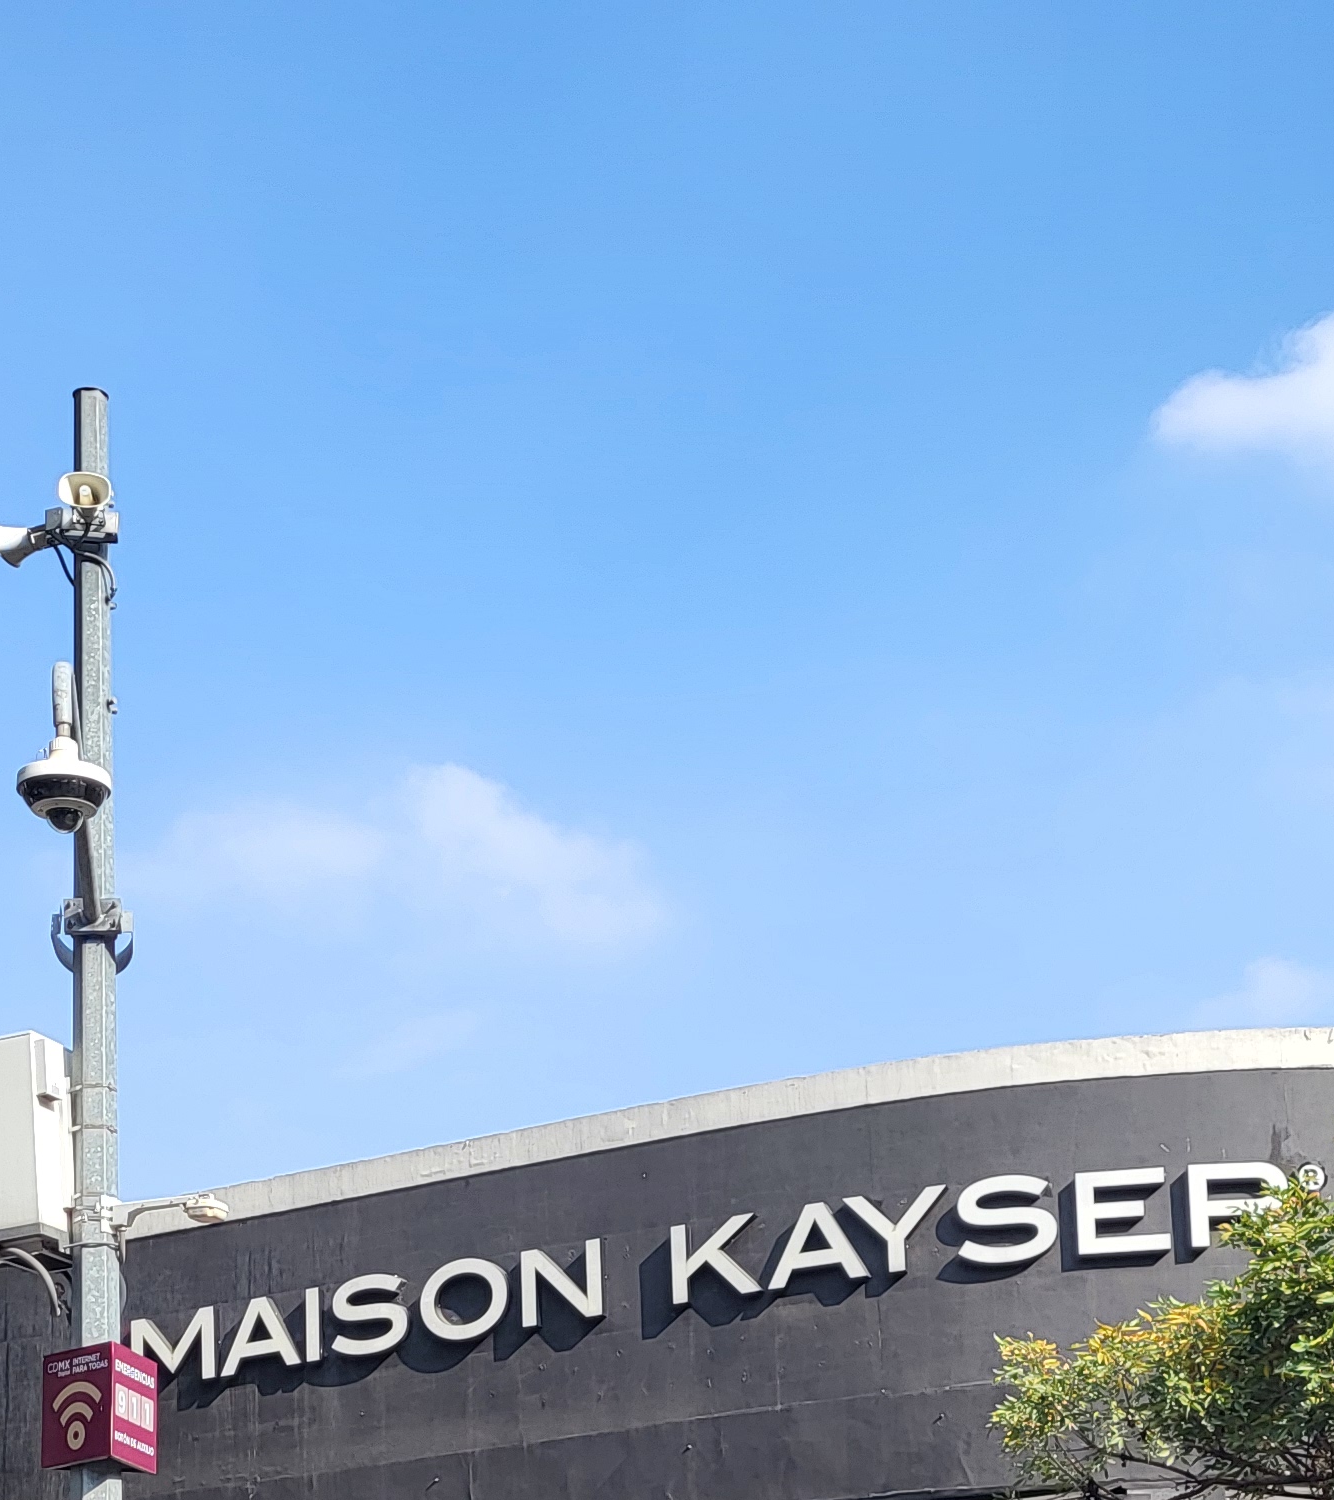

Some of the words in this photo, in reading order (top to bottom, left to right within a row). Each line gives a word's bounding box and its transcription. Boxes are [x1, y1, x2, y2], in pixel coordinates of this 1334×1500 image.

[130, 1237, 604, 1380] MAISON
[72, 1365, 88, 1375] PARA
[117, 1389, 151, 1427] 911
